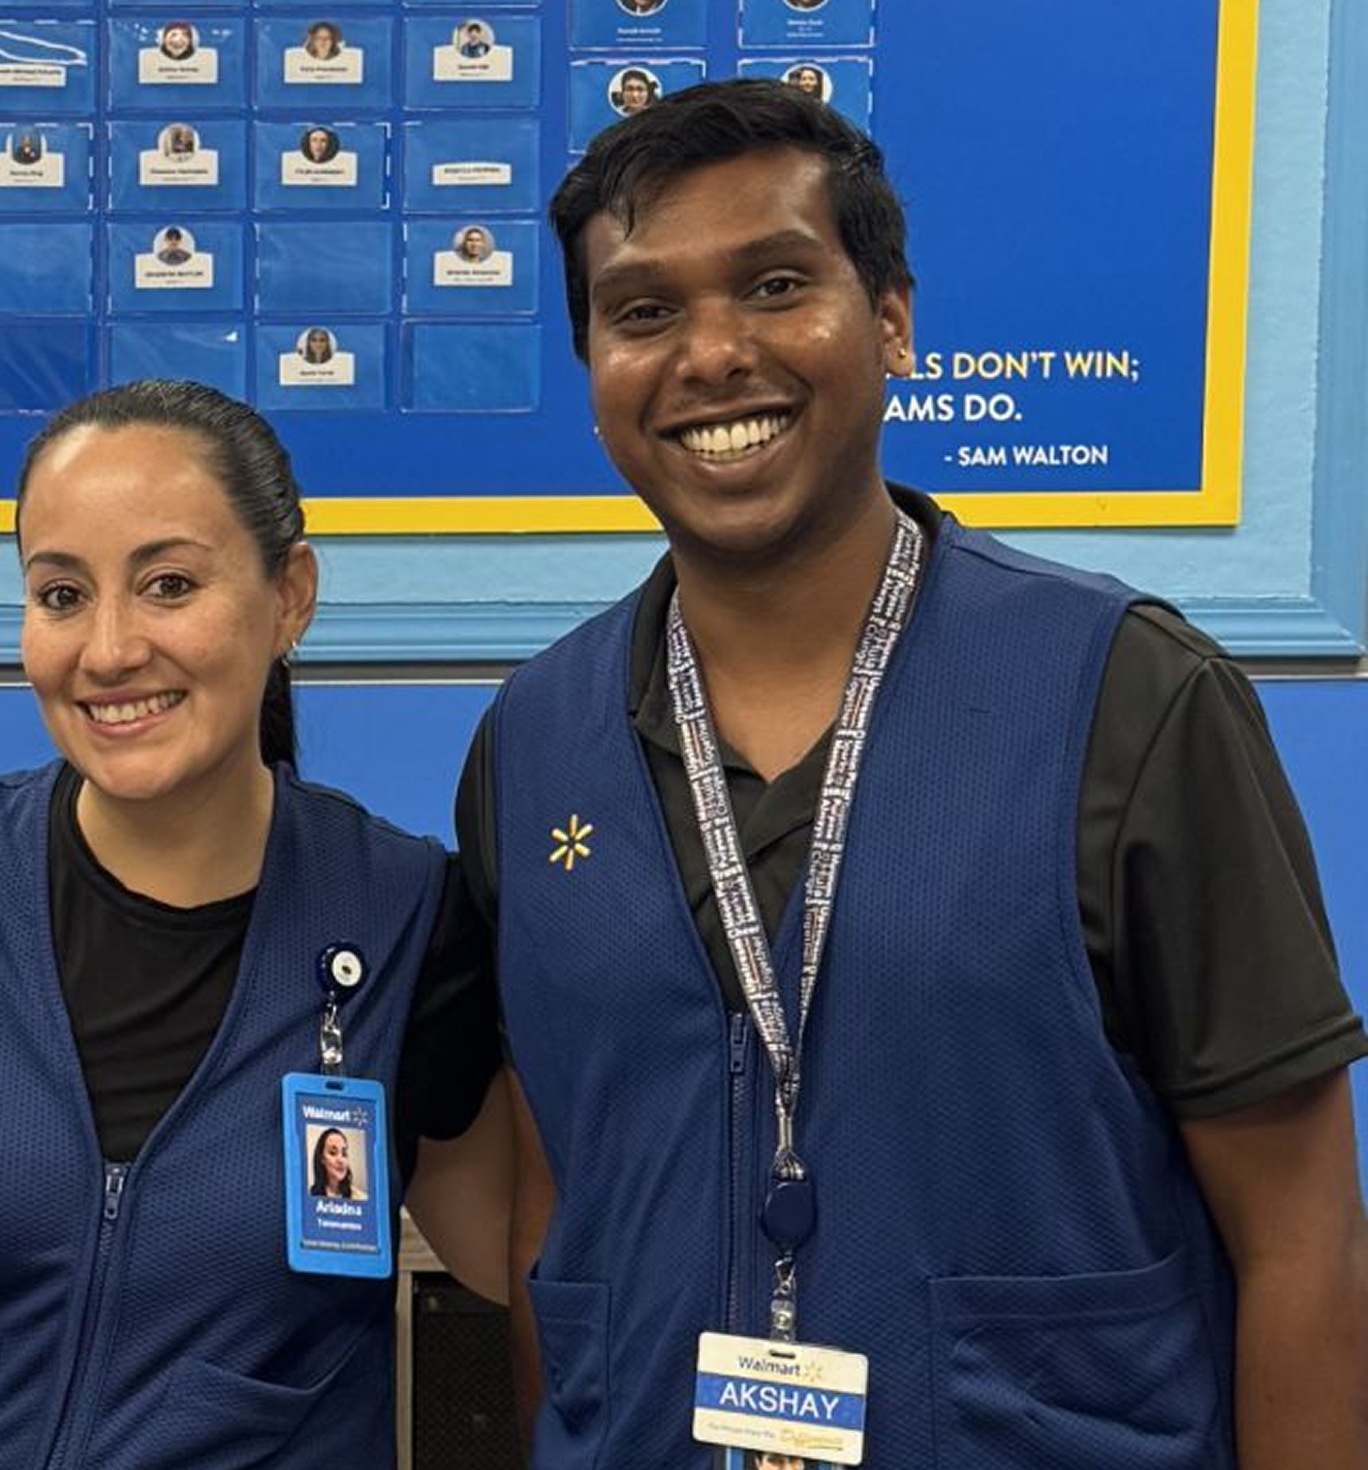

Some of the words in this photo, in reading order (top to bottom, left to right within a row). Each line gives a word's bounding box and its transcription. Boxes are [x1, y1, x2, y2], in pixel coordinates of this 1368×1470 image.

[953, 351, 1056, 380] DON'T
[1065, 350, 1140, 382] WIN;
[883, 394, 954, 421] AMS
[964, 394, 1023, 421] DO.
[958, 446, 1006, 466] SAM
[1013, 445, 1108, 466] WALTON
[302, 1105, 351, 1122] Walmart
[738, 1355, 801, 1376] Walmart
[719, 1381, 840, 1420] AKSHAY
